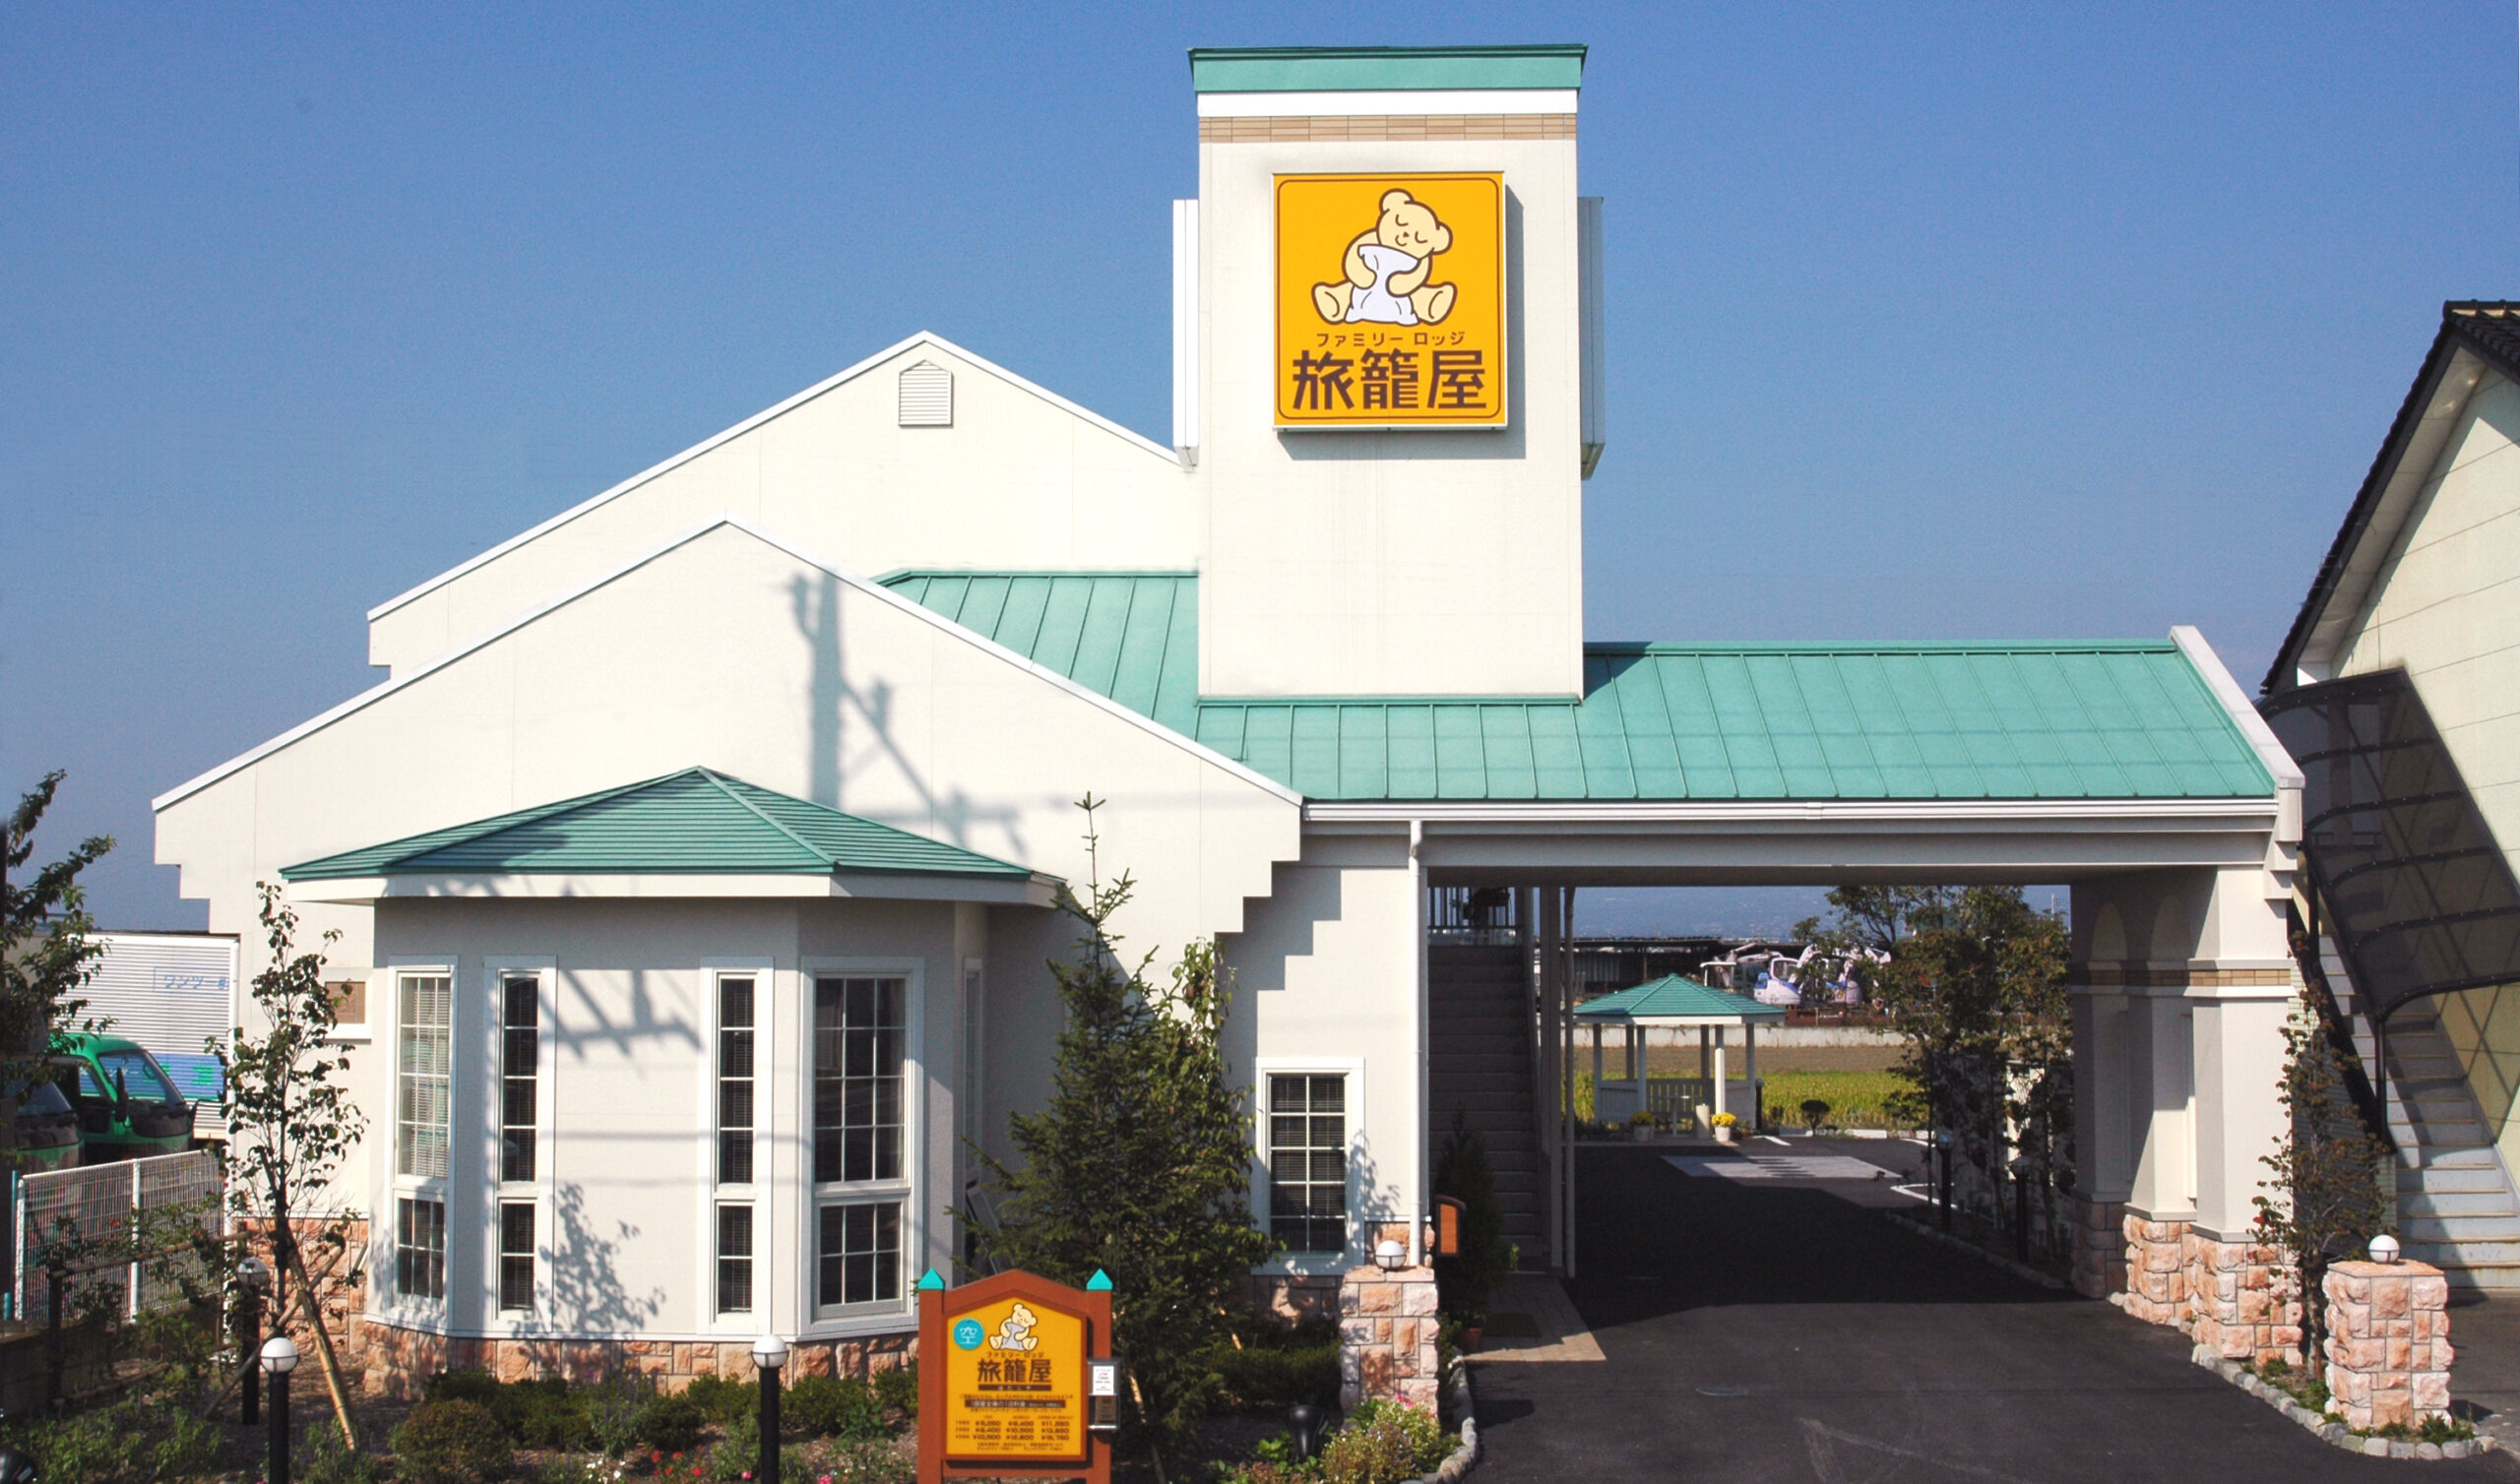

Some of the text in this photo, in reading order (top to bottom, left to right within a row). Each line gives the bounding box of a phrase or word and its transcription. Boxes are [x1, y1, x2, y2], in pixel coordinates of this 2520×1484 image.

[1316, 332, 1466, 347] ファミリー ロッジ
[1292, 347, 1487, 410] 旅籠屋
[959, 1326, 977, 1344] 空
[977, 1358, 1052, 1383] 旅籠屋
